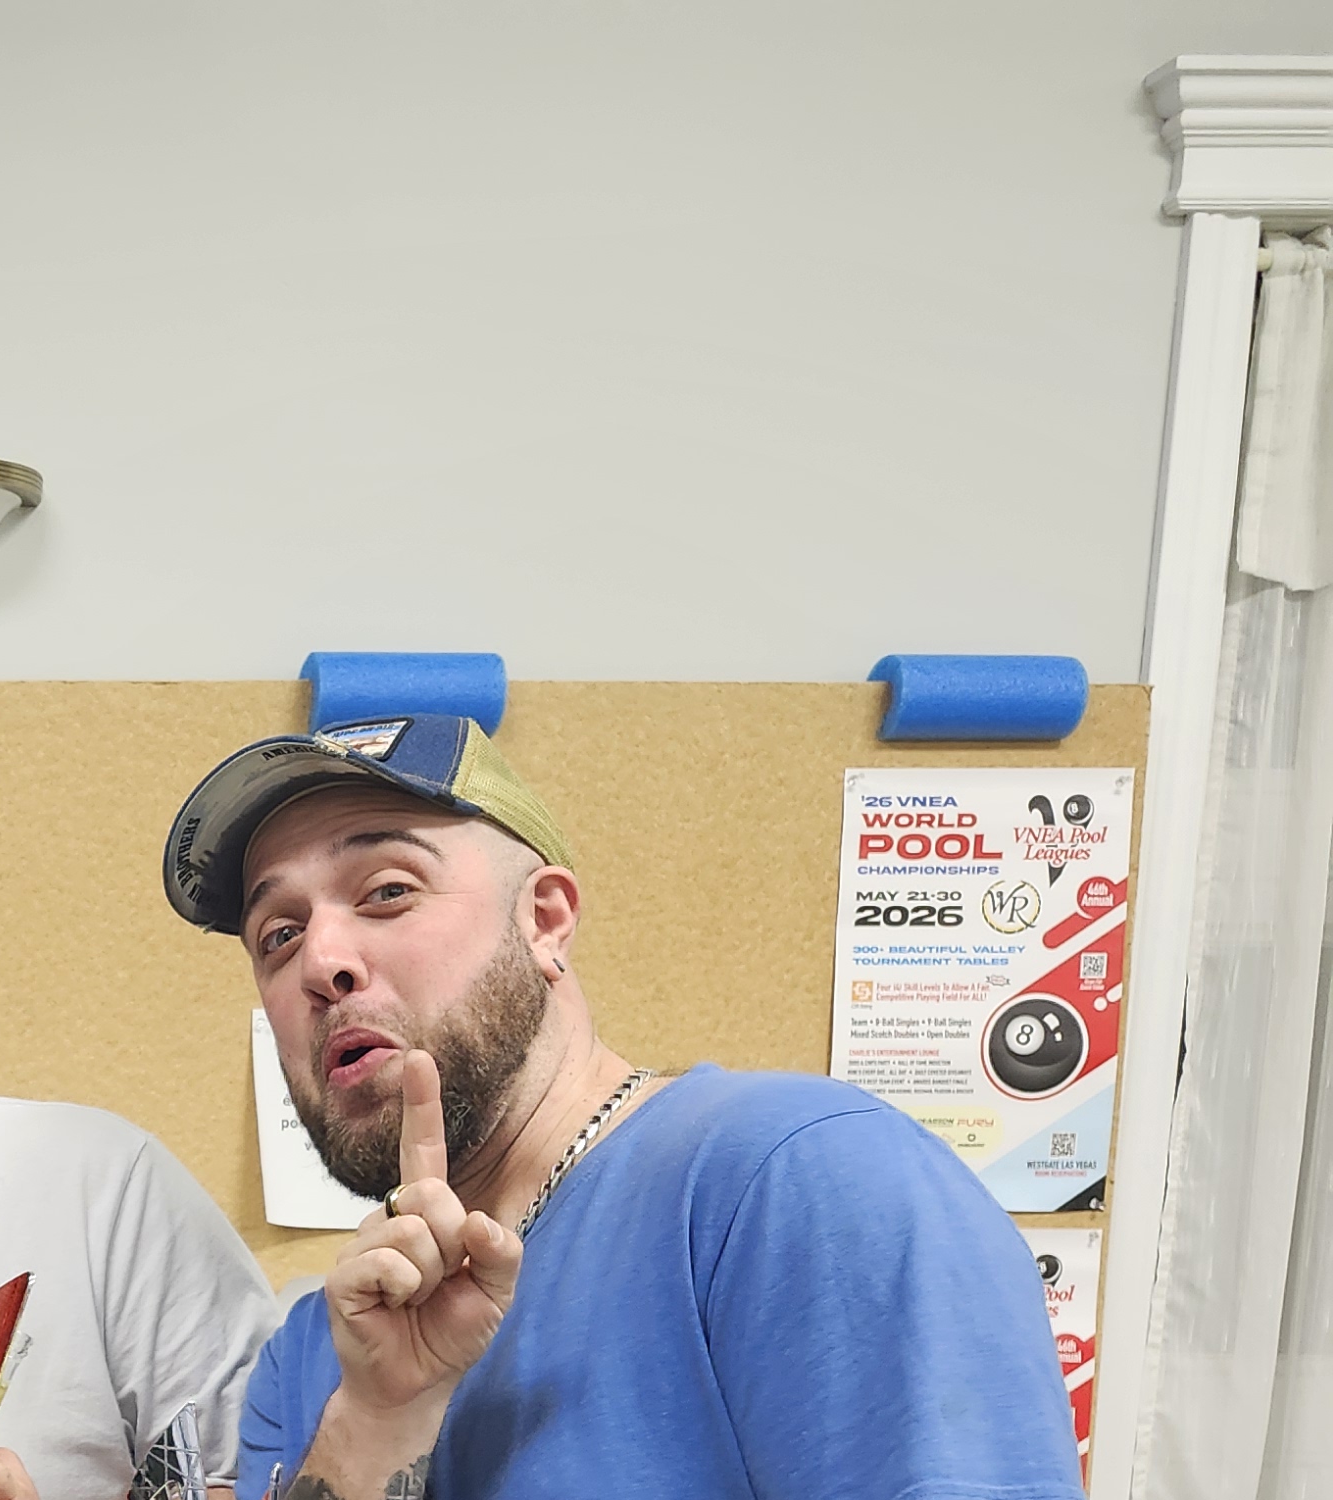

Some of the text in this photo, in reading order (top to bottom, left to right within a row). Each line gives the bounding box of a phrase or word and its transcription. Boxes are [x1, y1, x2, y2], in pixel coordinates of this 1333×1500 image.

[861, 795, 958, 807] '26 VNEA
[862, 813, 977, 828] WORLD
[1014, 826, 1108, 843] VNEA Pool
[858, 833, 1003, 860] POOL
[1023, 844, 1091, 865] Leagues
[857, 866, 1000, 875] CHAMPIONSHIPS
[856, 891, 899, 901] MAY
[854, 905, 964, 927] 2026
[889, 946, 967, 954] BEAUTIFUL
[973, 946, 1026, 954] VALLEY
[853, 958, 1009, 966] TOURNAMENT TABLES
[851, 1018, 868, 1026] Team
[850, 1030, 970, 1040] Mixed Scotch Doubles Open Doubles
[1015, 1024, 1034, 1046] 8
[1061, 1161, 1074, 1169] LAS
[1075, 1161, 1097, 1169] VEGAS
